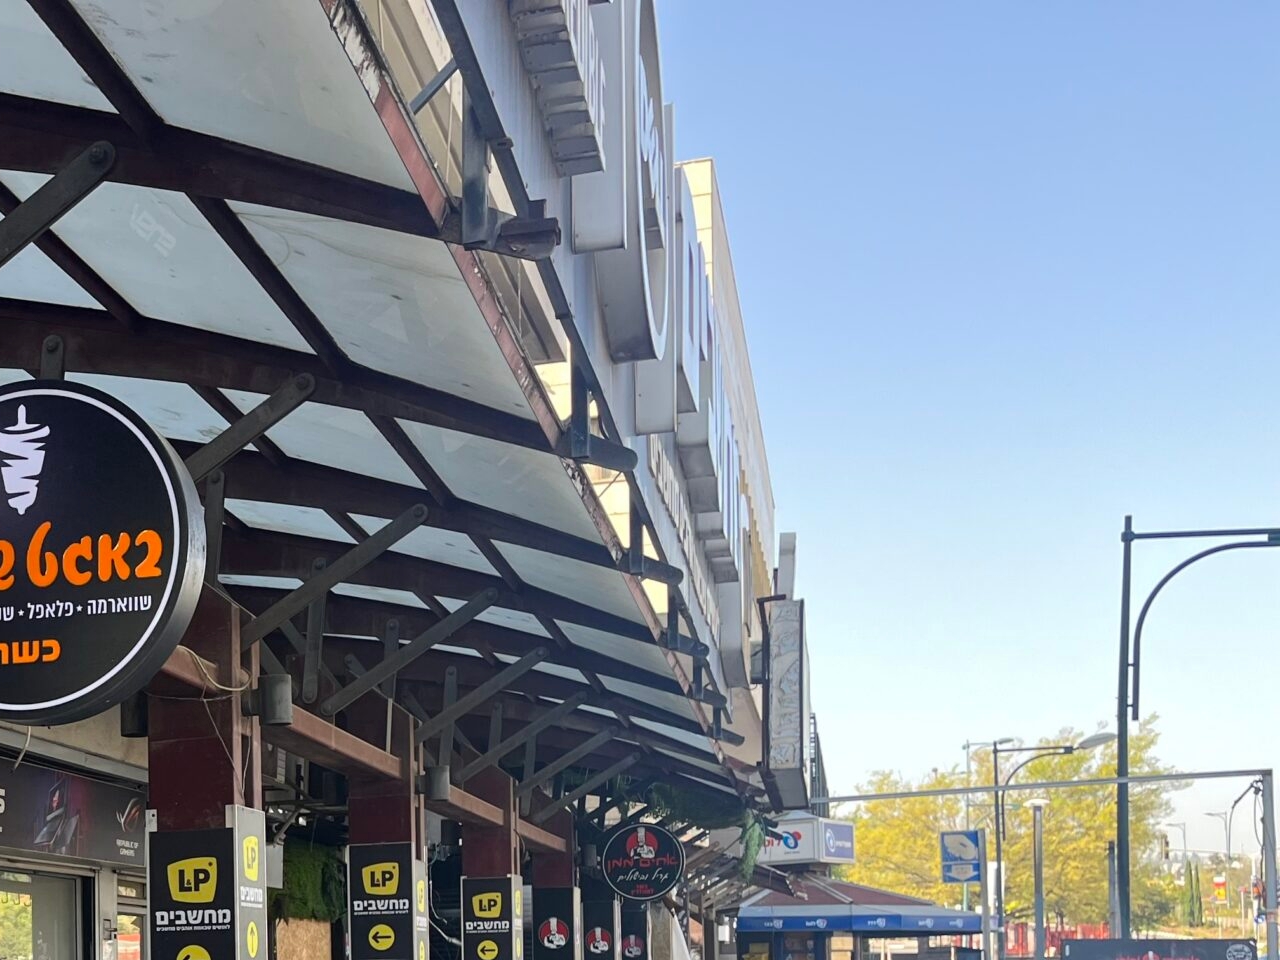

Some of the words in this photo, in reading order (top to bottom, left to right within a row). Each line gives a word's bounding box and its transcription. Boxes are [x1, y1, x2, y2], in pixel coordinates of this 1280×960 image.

[26, 521, 163, 588] באגט
[27, 600, 74, 620] פלאפל
[87, 595, 152, 615] שווארמה
[353, 899, 410, 911] מחשבים
[155, 908, 231, 926] מחשבים
[465, 920, 510, 931] מחשבים
